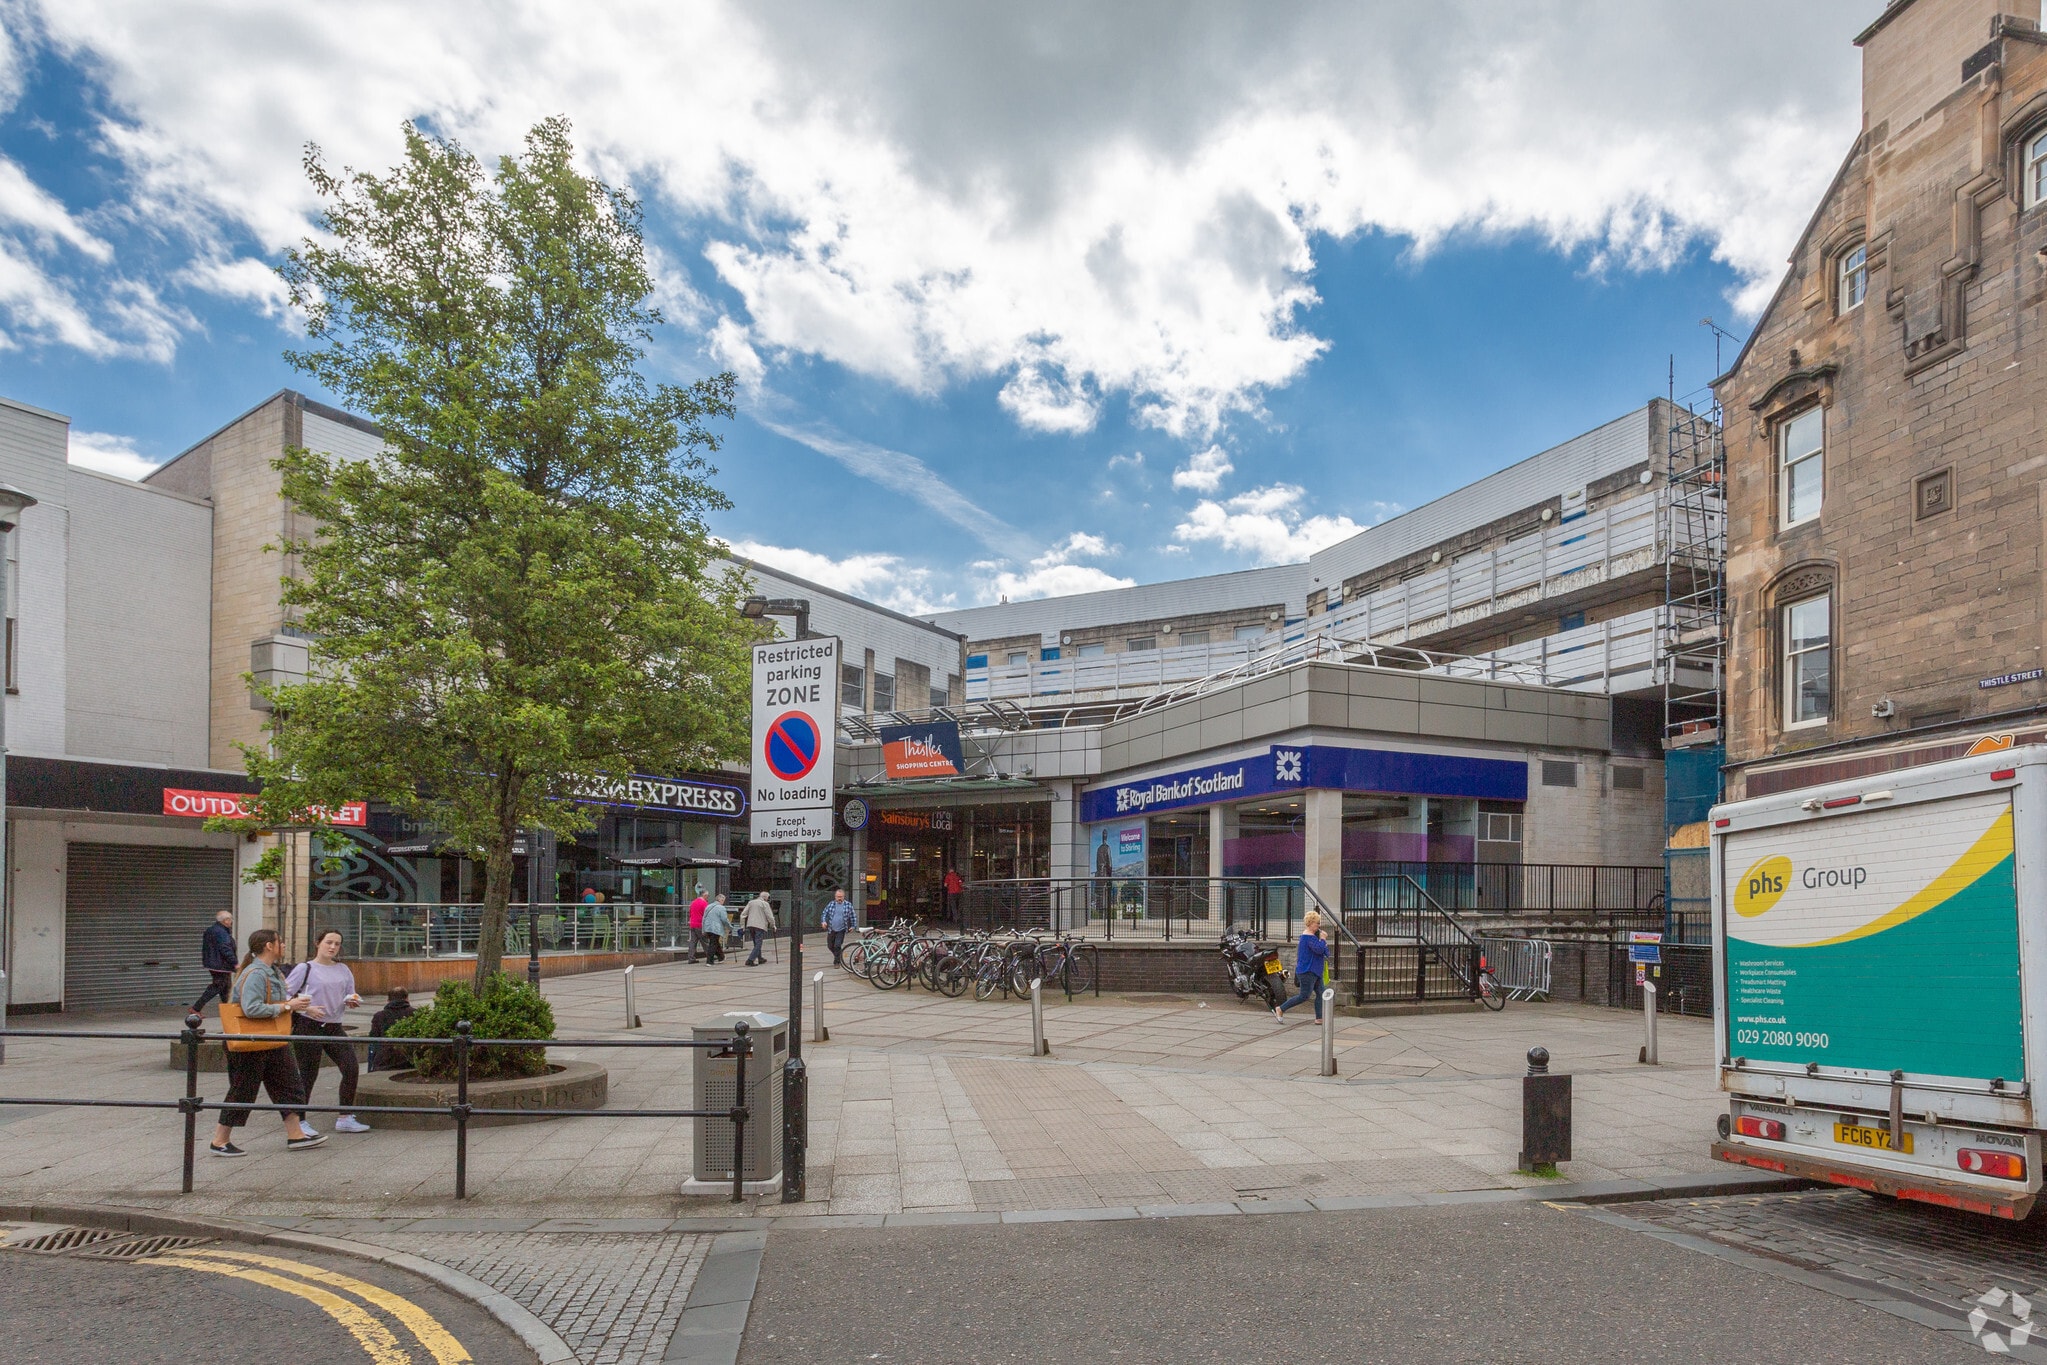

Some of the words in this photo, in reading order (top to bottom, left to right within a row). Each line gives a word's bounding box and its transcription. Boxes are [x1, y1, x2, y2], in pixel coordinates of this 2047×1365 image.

[757, 642, 833, 665] Restricted
[766, 664, 822, 685] parking
[1979, 675, 2010, 688] THISTLE
[2011, 669, 2043, 682] STREET
[766, 684, 820, 707] ZONE
[898, 733, 942, 759] Thistles
[896, 762, 928, 770] SHOPPING
[929, 759, 954, 768] CENTRE
[757, 788, 775, 802] No
[779, 786, 827, 801] loading
[1129, 785, 1154, 811] Royal
[1156, 781, 1180, 802] Bank
[1181, 777, 1195, 798] of
[1195, 767, 1245, 795] Scotland
[776, 816, 806, 826] Except
[881, 810, 930, 830] Sainsbury's
[931, 812, 953, 831] Local
[760, 829, 769, 838] in
[771, 827, 799, 839] signed
[801, 827, 822, 838] bays
[1120, 833, 1141, 842] Welcome
[1749, 871, 1783, 900] phs
[1802, 866, 1867, 890] Group
[1764, 959, 1785, 967] Services
[1766, 979, 1787, 987] Matting
[1740, 996, 1763, 1004] Specialist
[1763, 997, 1785, 1005] Cleaning
[1737, 1015, 1787, 1024] www.phs.co.uk
[1737, 1029, 1760, 1044] 029
[1762, 1030, 1793, 1046] 2080
[1795, 1032, 1830, 1049] 9090
[1749, 1103, 1794, 1116] VAUXHALL
[1841, 1126, 1873, 1146] FC16
[1875, 1131, 1896, 1149] YZ
[1975, 1134, 2025, 1149] MOVAN
